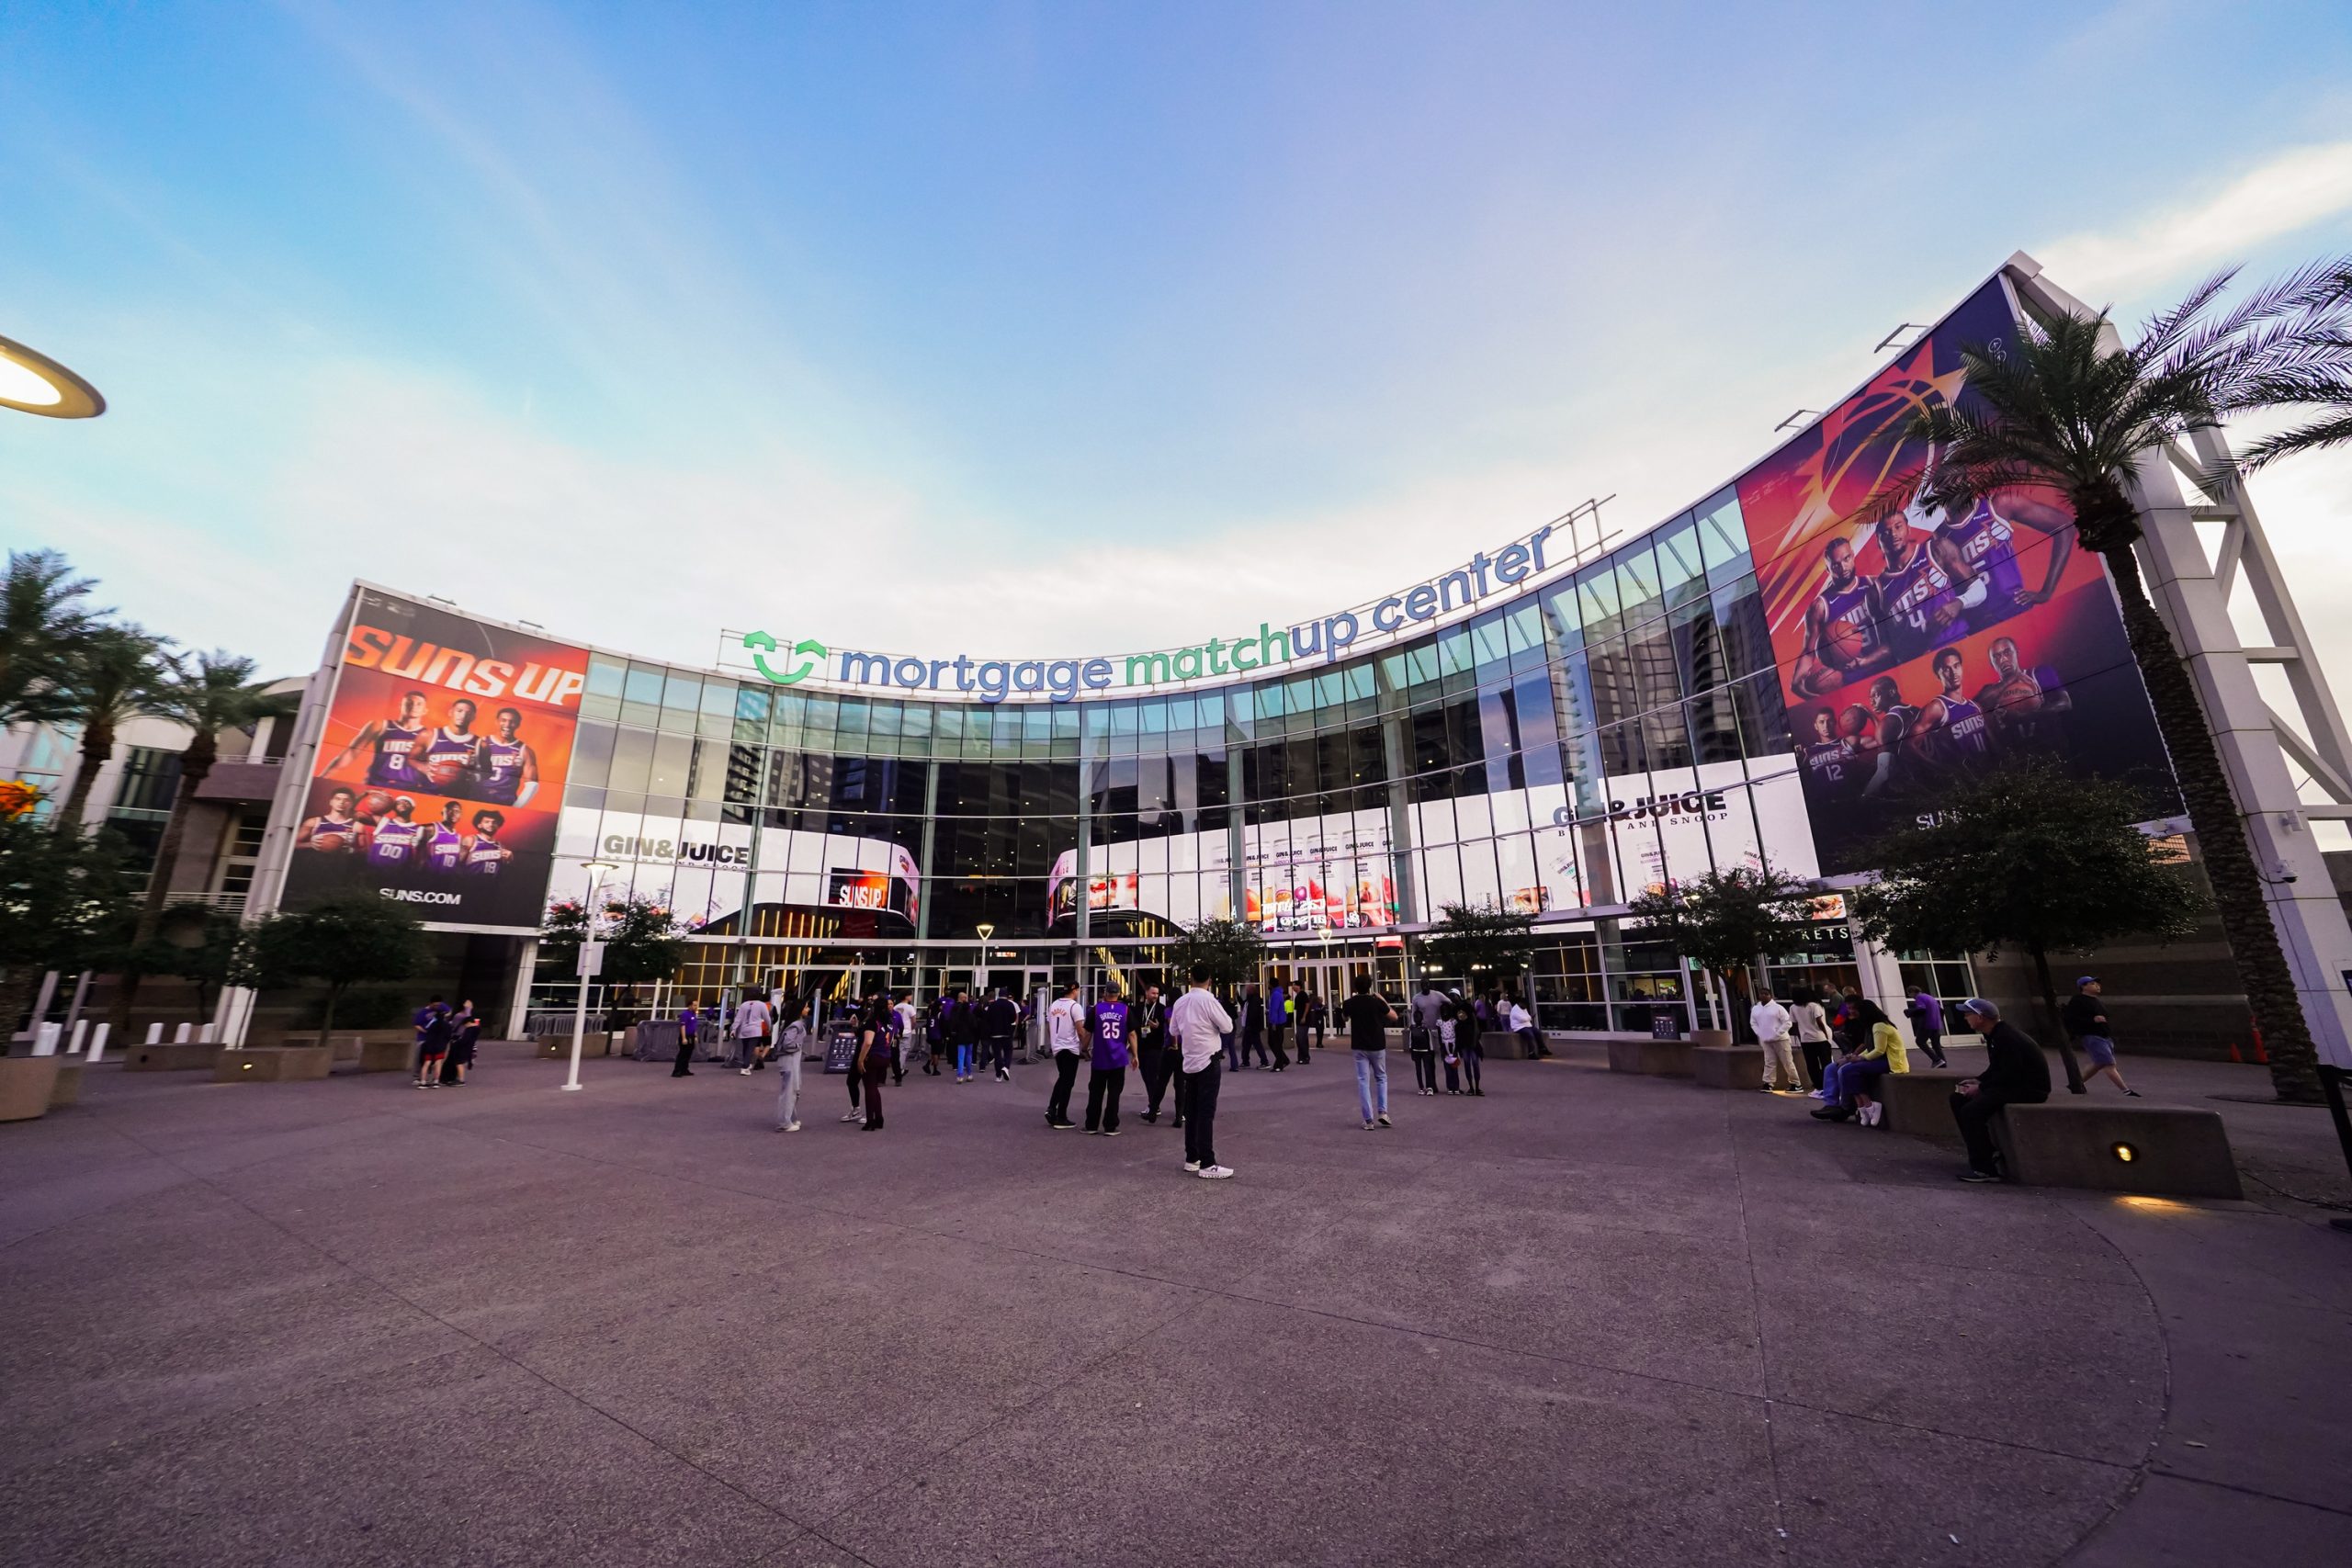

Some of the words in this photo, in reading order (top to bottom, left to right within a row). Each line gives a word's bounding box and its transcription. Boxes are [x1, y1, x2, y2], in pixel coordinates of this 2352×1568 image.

[841, 650, 1113, 704] mortgage
[1125, 611, 1359, 686] matchup
[1373, 525, 1552, 632] center
[1908, 609, 1927, 634] 4
[345, 625, 515, 698] SUNS
[512, 661, 586, 706] UP
[389, 753, 405, 771] 8
[1825, 763, 1845, 782] 12
[379, 843, 403, 860] 00
[379, 887, 462, 906] SUNS.COM
[1102, 1021, 1121, 1040] 25
